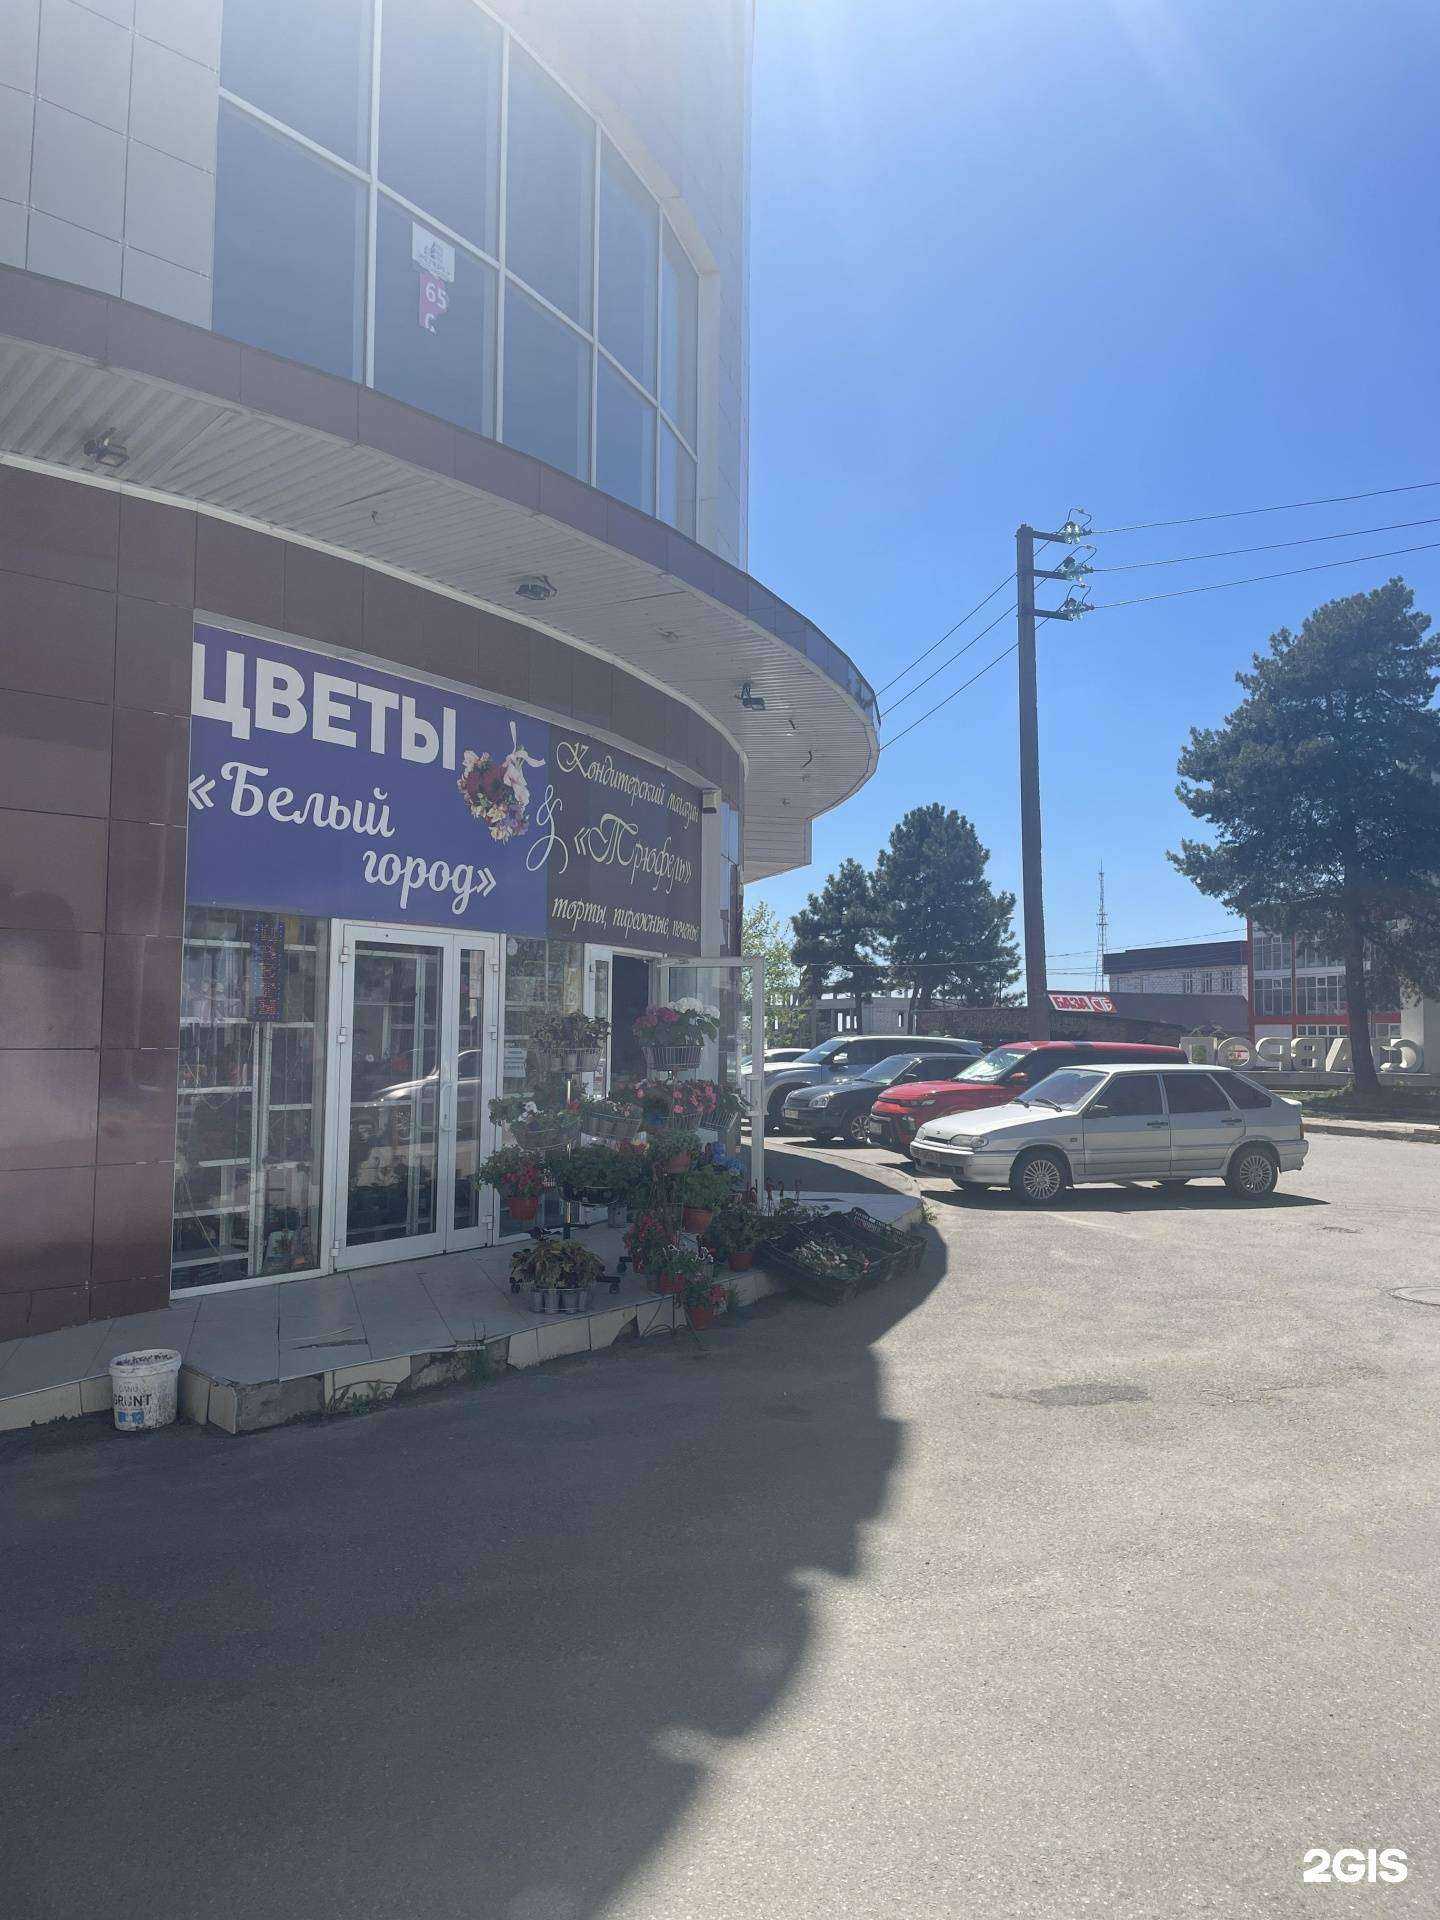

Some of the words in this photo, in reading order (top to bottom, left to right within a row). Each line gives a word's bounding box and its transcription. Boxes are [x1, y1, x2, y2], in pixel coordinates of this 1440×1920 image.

[191, 641, 457, 771] ЦВЕТЫ
[188, 761, 396, 838] «Белый
[556, 741, 666, 807] Кондитерский
[363, 850, 497, 915] город»
[574, 813, 692, 895] «Трюфель»
[551, 896, 607, 932] торты,
